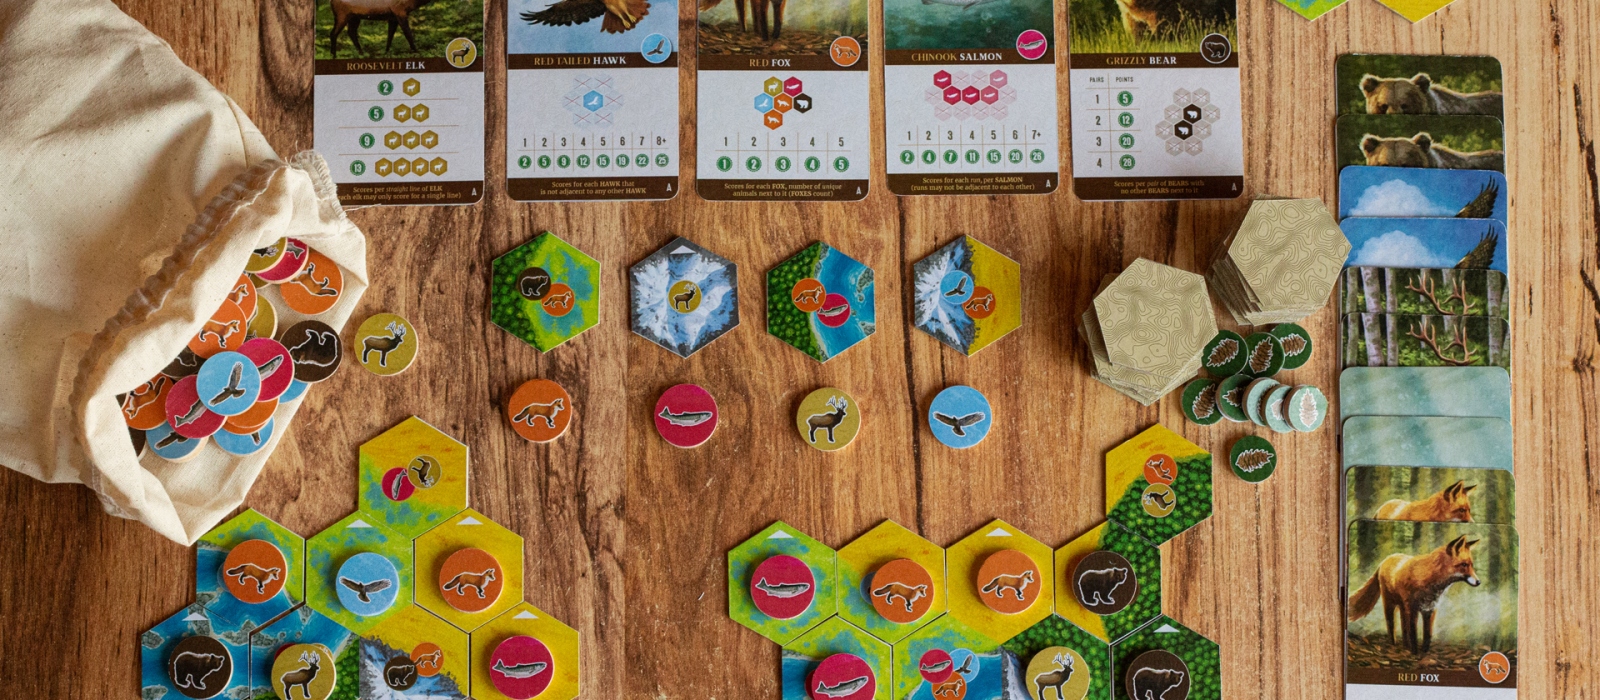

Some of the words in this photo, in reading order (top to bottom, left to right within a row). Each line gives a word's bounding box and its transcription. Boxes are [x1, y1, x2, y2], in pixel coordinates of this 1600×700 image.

[534, 57, 553, 65] RED
[557, 57, 590, 65] TAILED
[593, 56, 626, 65] HAWK
[911, 52, 957, 61] CHINOOK
[960, 52, 1002, 61] SALMON
[1106, 56, 1146, 65] GRIZZLY
[1150, 56, 1177, 65] BEAR
[347, 62, 403, 71] ROOSEVELT
[771, 59, 791, 67] FOX
[383, 83, 388, 92] 2
[1096, 94, 1099, 103] 1
[1122, 94, 1128, 103] 5
[374, 109, 379, 119] 5
[1096, 116, 1100, 125] 2
[1122, 115, 1130, 124] 12
[908, 131, 911, 140] 1
[926, 131, 931, 140] 2
[948, 131, 953, 140] 3
[970, 130, 975, 140] 4
[991, 130, 996, 140] 5
[1013, 130, 1018, 139] 6
[1032, 130, 1041, 139] 7+
[364, 136, 370, 146] 9
[523, 138, 527, 147] 1
[542, 138, 547, 147] 2
[561, 137, 566, 146] 3
[581, 137, 586, 146] 4
[600, 137, 606, 146] 5
[620, 137, 625, 146] 6
[640, 137, 644, 146] 7
[657, 136, 666, 146] 8+
[724, 137, 727, 146] 1
[751, 137, 756, 146] 2
[781, 137, 786, 146] 3
[810, 137, 815, 146] 4
[839, 137, 844, 147] 5
[1096, 136, 1101, 146] 3
[1122, 136, 1131, 145] 20
[904, 153, 910, 161] 2
[926, 153, 932, 161] 4
[948, 152, 953, 161] 7
[969, 152, 976, 161] 11
[990, 152, 998, 161] 15
[1011, 152, 1020, 161] 20
[1033, 152, 1041, 160] 26
[522, 158, 527, 166] 2
[542, 157, 547, 166] 5
[561, 157, 566, 166] 9
[580, 157, 587, 166] 12
[599, 157, 606, 165] 15
[618, 157, 626, 165] 19
[638, 157, 646, 165] 22
[658, 157, 666, 165] 25
[722, 160, 726, 169] 1
[751, 160, 756, 169] 2
[780, 160, 786, 169] 3
[810, 160, 815, 169] 4
[839, 160, 844, 169] 5
[1097, 158, 1102, 168] 4
[1123, 158, 1132, 167] 28
[354, 163, 361, 172] 13
[1398, 673, 1418, 682] RED
[1420, 674, 1439, 682] FOX
